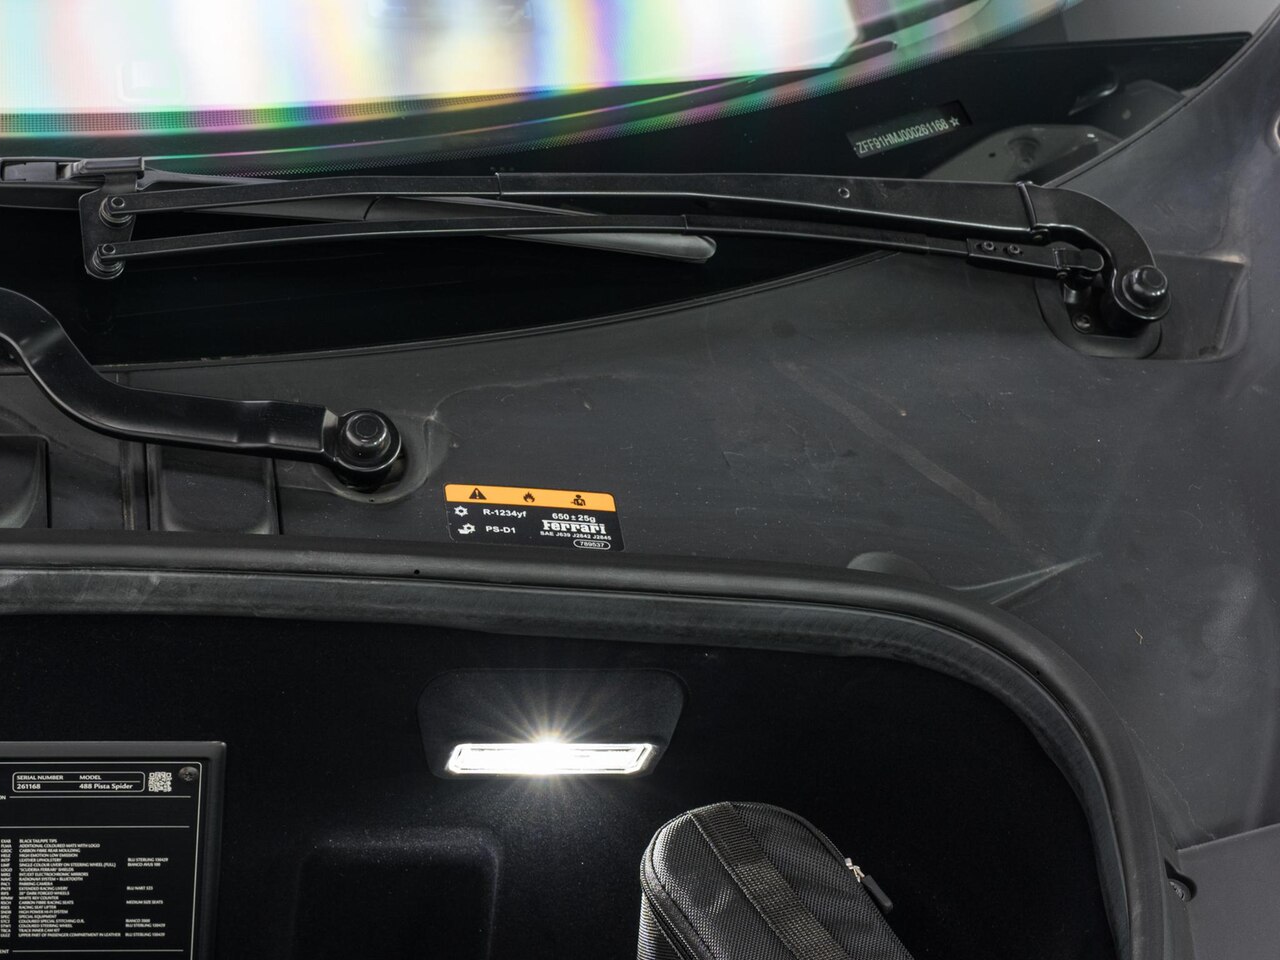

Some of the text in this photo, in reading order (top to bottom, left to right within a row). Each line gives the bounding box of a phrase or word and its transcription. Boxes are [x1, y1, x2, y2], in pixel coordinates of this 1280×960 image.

[483, 508, 527, 518] R-1234yf
[552, 512, 570, 520] 650
[578, 514, 596, 523] 25g
[486, 526, 516, 534] PS-D1
[542, 519, 607, 535] Ferrari
